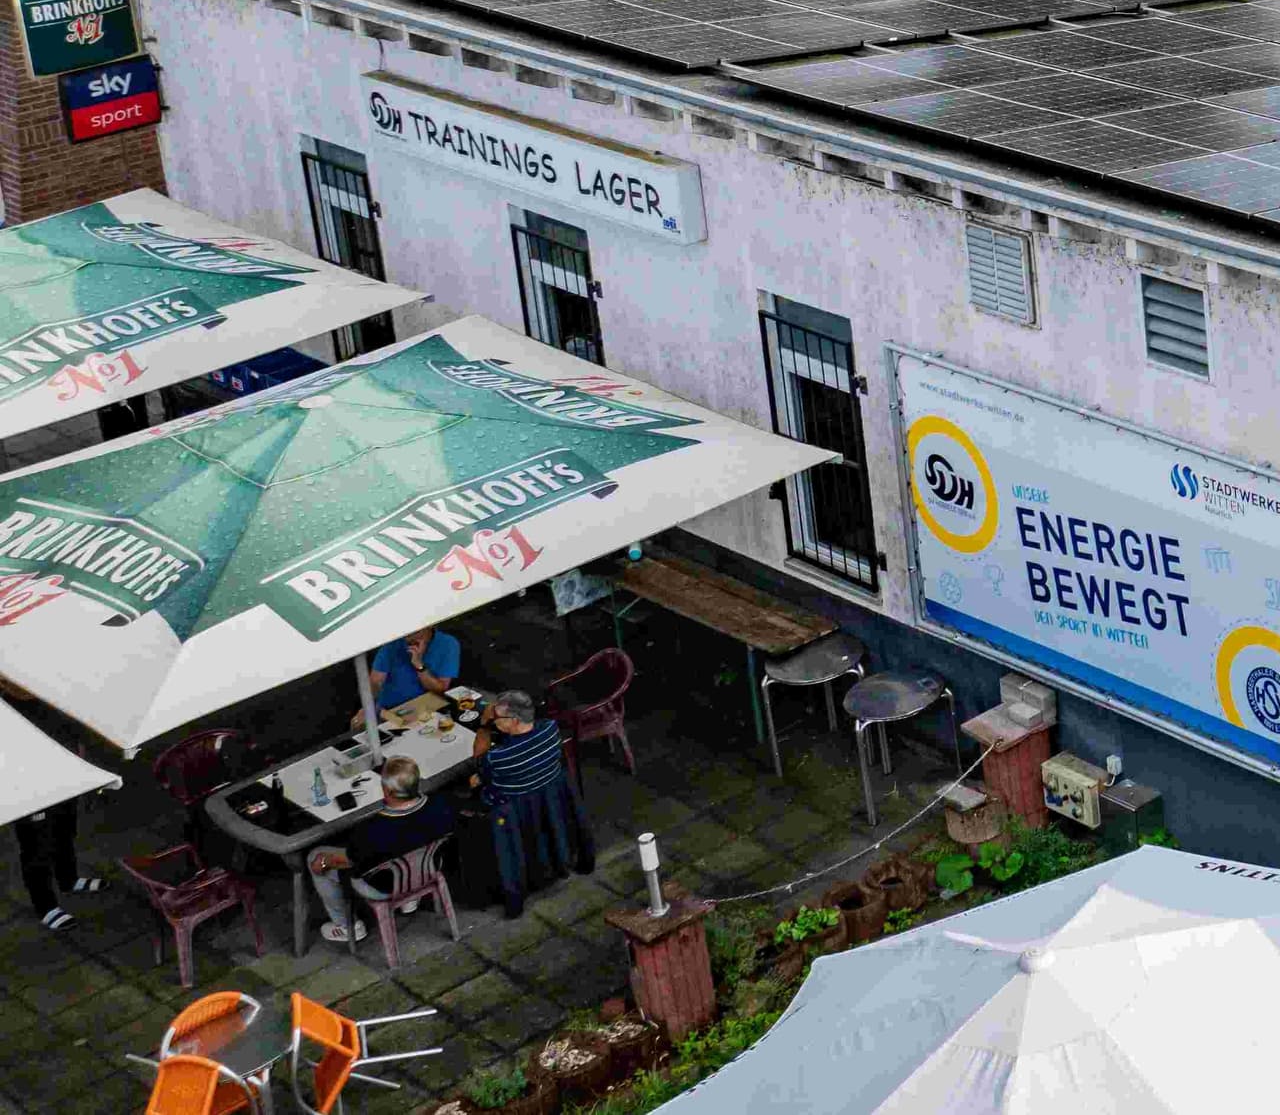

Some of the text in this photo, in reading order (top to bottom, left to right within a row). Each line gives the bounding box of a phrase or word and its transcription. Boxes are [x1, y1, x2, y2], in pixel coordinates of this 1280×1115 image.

[88, 72, 132, 97] sky
[91, 104, 143, 128] sport
[408, 111, 557, 183] TRAININGS
[575, 161, 663, 217] LAGER
[0, 297, 197, 388] INKHOFF's
[1203, 492, 1245, 515] WITTEN
[1016, 506, 1186, 581] ENERGIE
[1026, 561, 1189, 637] BEWEGT
